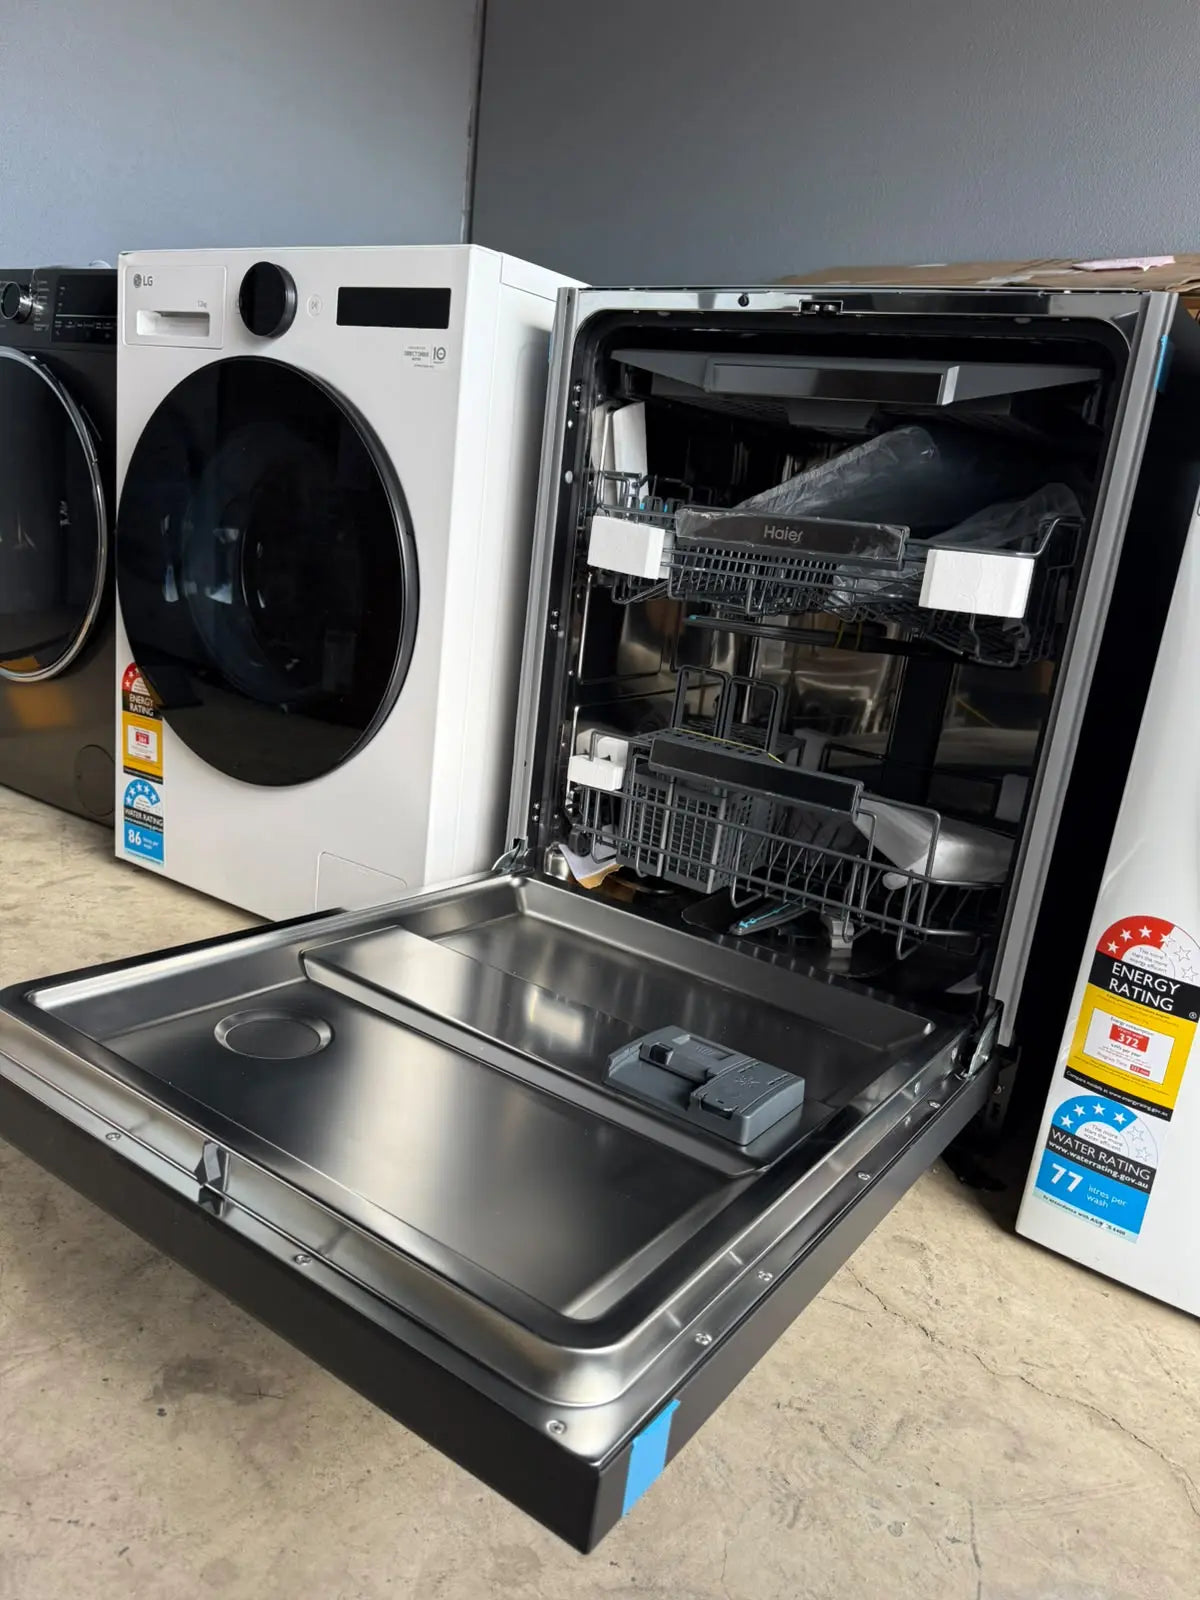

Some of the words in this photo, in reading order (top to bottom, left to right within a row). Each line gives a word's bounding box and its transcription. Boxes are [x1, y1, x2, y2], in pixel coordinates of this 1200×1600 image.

[143, 275, 153, 287] LG
[763, 524, 804, 544] Haier
[129, 693, 154, 707] ENERGY
[129, 702, 154, 717] RATING
[143, 812, 164, 827] RATING
[128, 829, 142, 846] 86
[1112, 962, 1180, 995] ENERGY
[1109, 978, 1174, 1011] RATING
[1117, 1033, 1139, 1048] 372
[1066, 1070, 1086, 1084] Compare
[1052, 1128, 1095, 1159] WATER
[1098, 1151, 1152, 1181] RATING
[1048, 1141, 1149, 1189] www.waterrating.gov.au
[1051, 1163, 1084, 1193] 77
[1086, 1194, 1109, 1208] wash
[1088, 1185, 1109, 1200] litres
[1111, 1194, 1128, 1207] per
